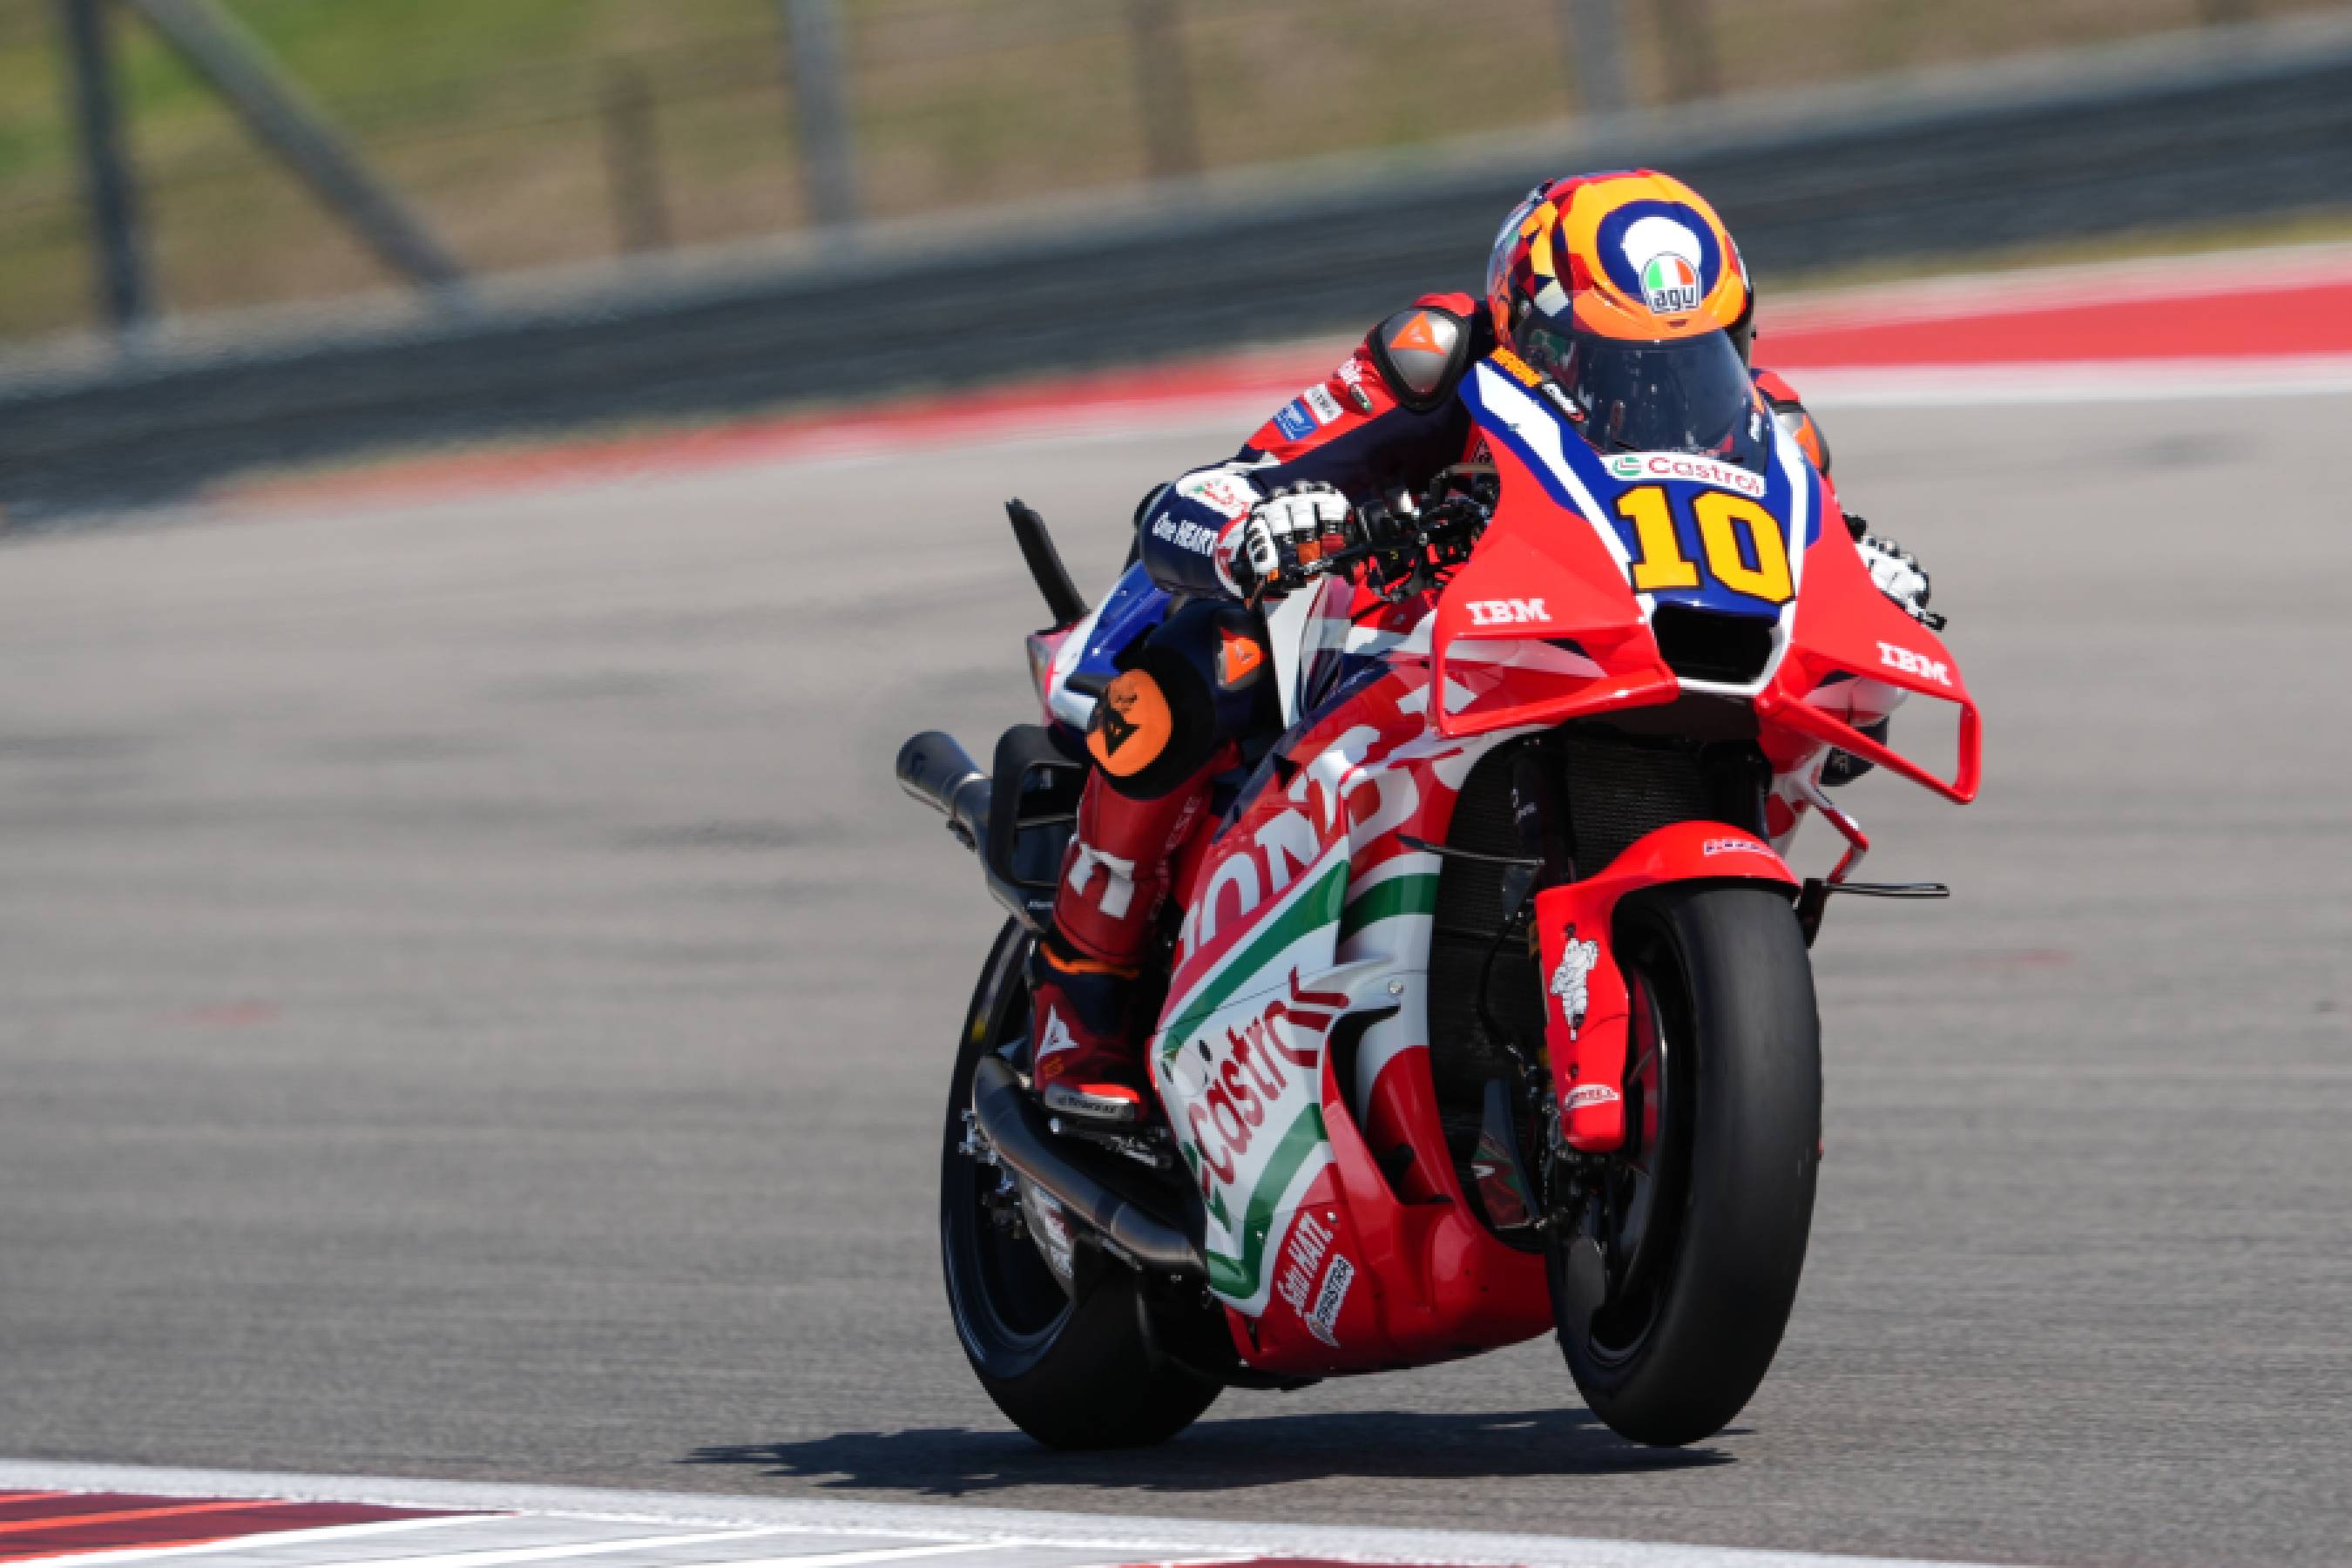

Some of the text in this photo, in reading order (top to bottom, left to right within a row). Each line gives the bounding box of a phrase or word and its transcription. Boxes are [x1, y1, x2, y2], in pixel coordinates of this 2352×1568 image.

[1647, 456, 1761, 495] Castrol
[1612, 483, 1797, 605] 10
[1466, 598, 1551, 625] IBM
[1876, 640, 1952, 686] IBM
[1188, 965, 1350, 1185] Castrol
